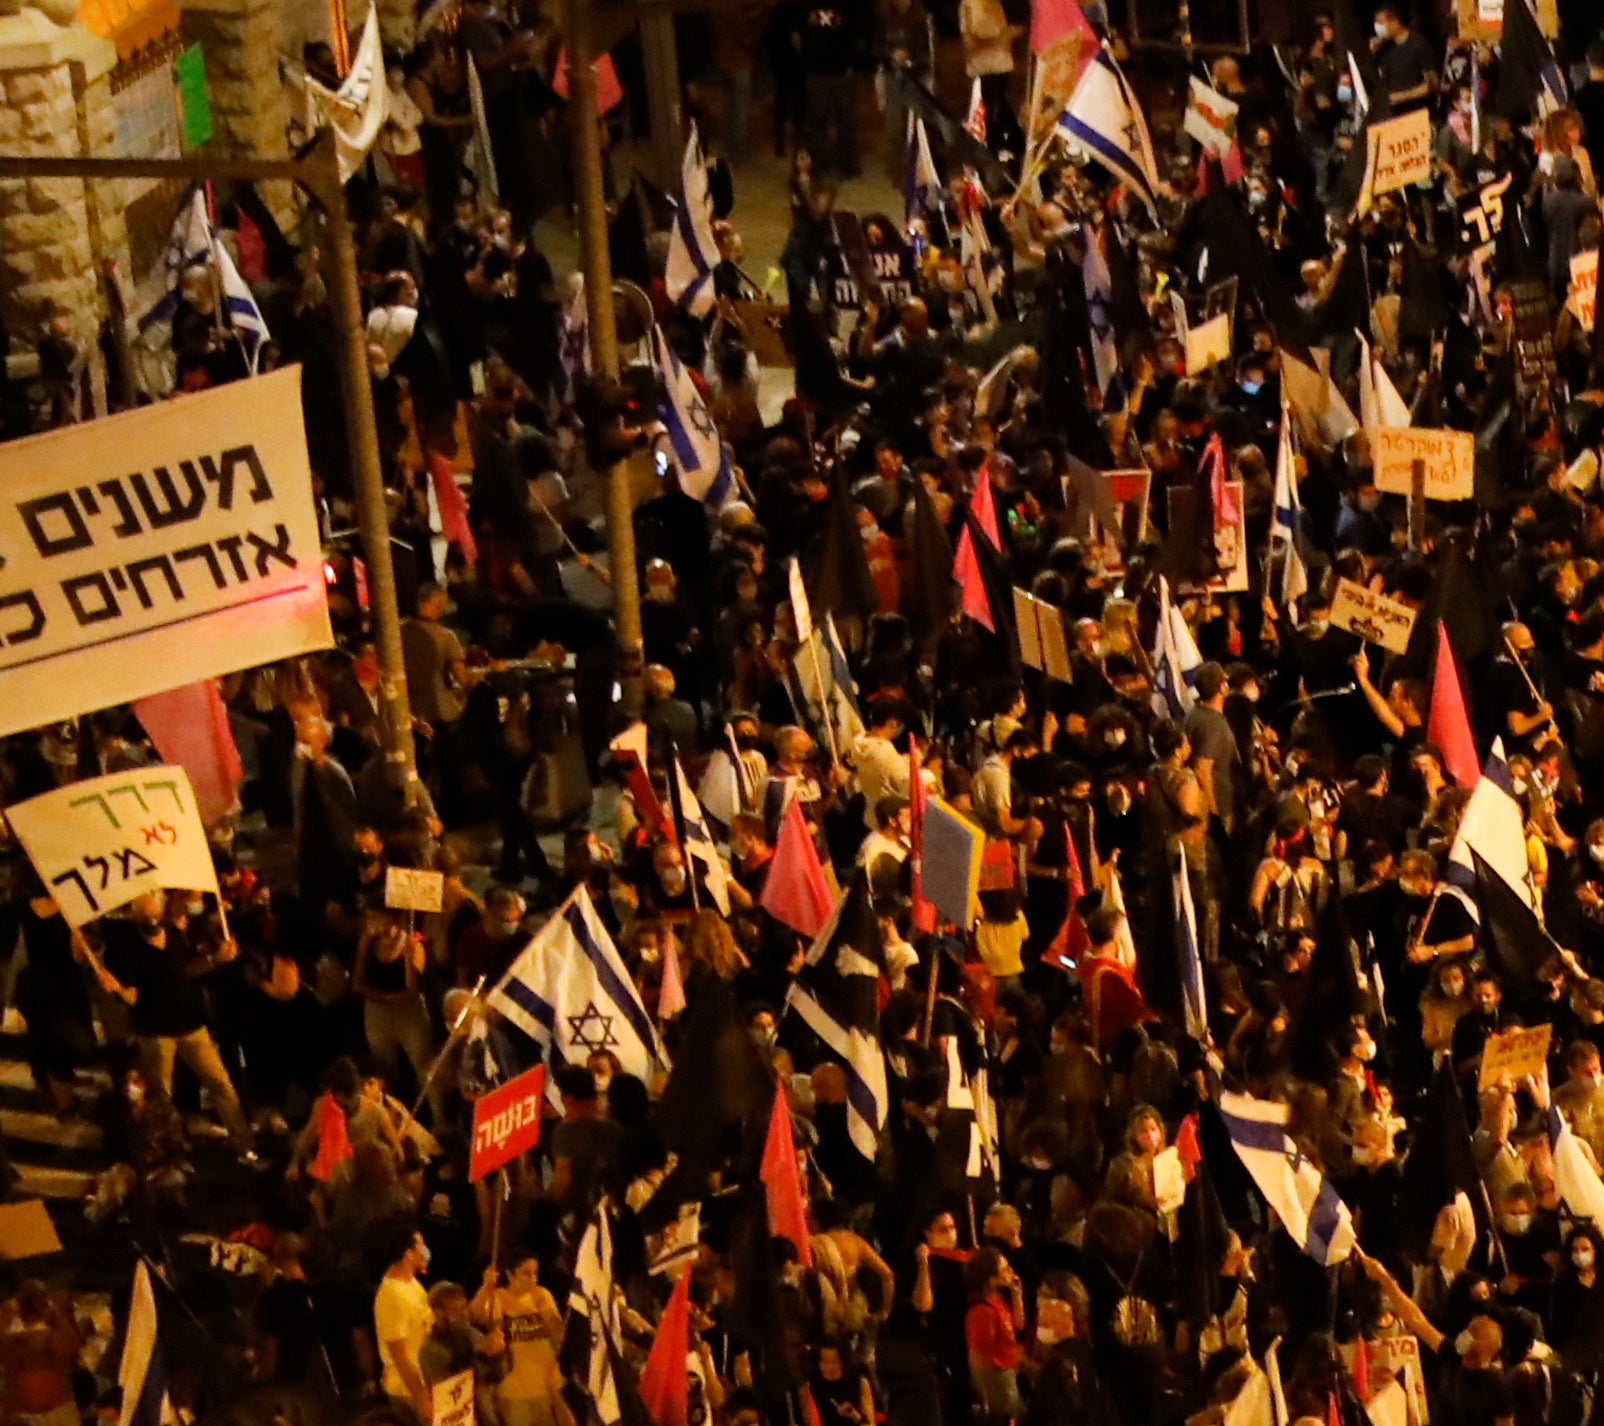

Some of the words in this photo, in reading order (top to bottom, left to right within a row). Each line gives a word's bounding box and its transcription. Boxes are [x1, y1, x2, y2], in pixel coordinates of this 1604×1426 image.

[17, 444, 275, 558] משנים
[71, 524, 298, 626] אזרחים
[68, 780, 184, 829] דרך
[139, 820, 178, 849] לא
[49, 846, 158, 912] מלך
